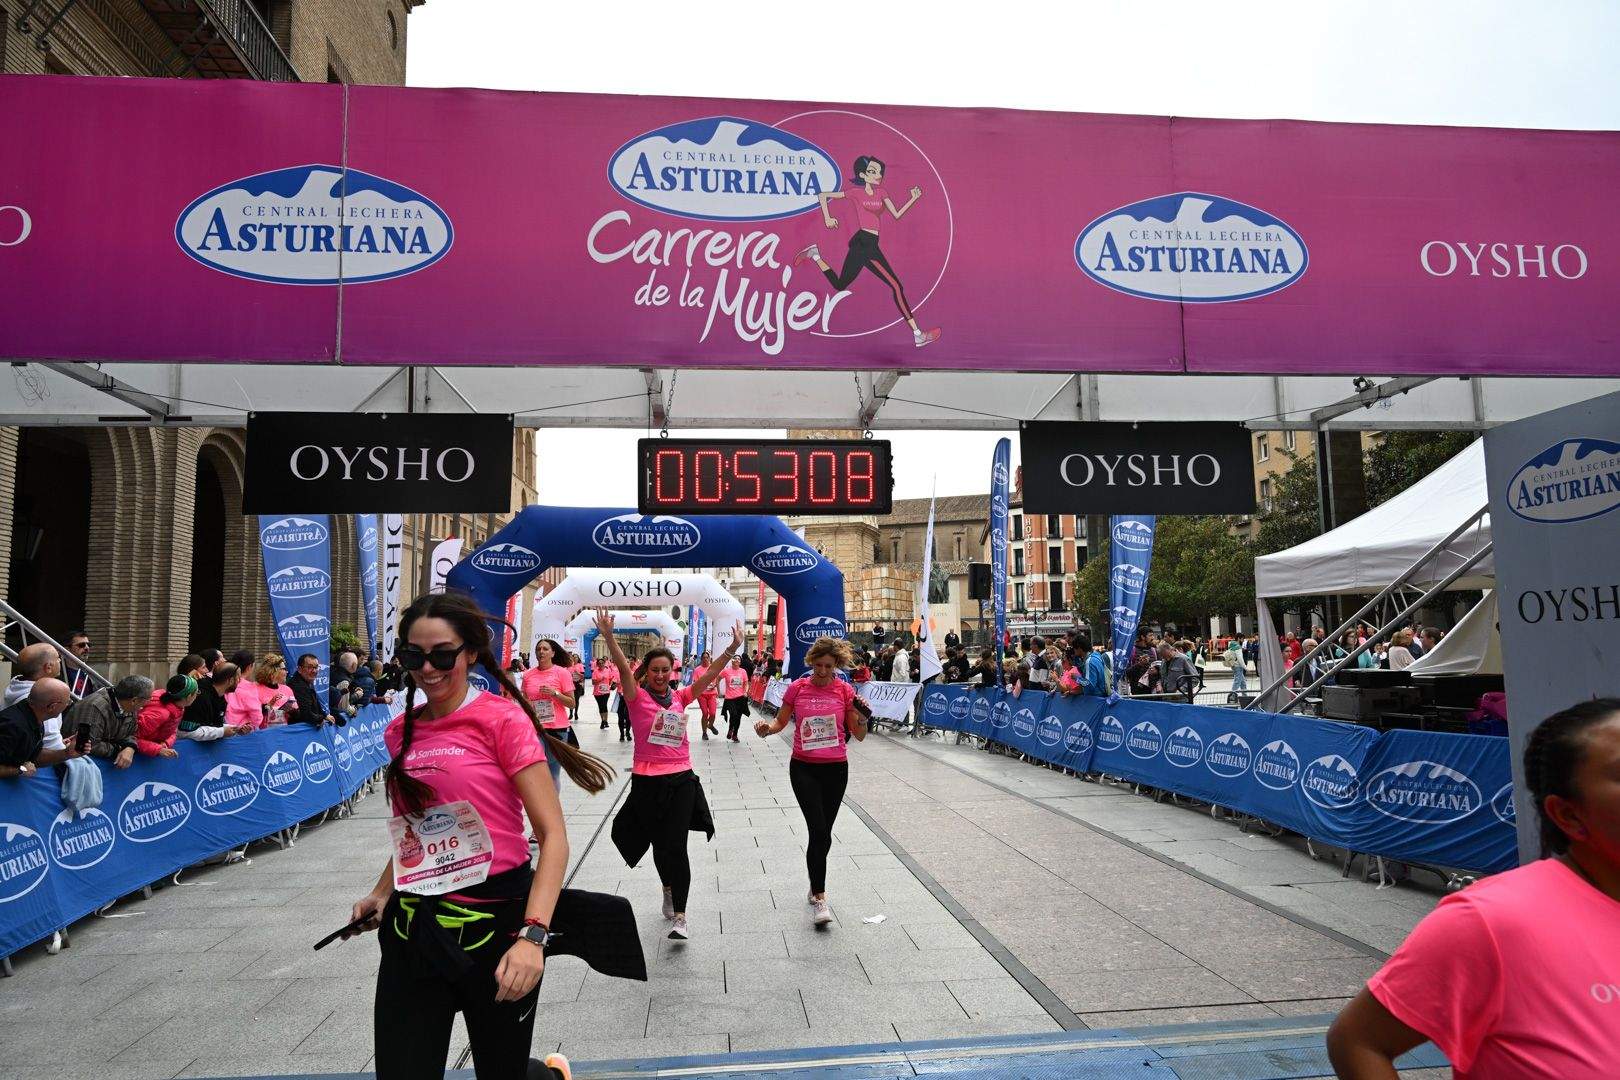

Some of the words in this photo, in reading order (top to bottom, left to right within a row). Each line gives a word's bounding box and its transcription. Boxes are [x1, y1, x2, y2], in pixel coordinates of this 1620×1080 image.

[663, 150, 737, 164] CENTRAL
[743, 153, 816, 166] LECHERA
[626, 151, 823, 197] ASTURIANA
[242, 205, 328, 218] CENTRAL
[337, 205, 424, 220] LECHERA
[197, 207, 433, 255] ASTURIANA
[586, 210, 780, 269] Carrera
[1129, 228, 1202, 242] CENTRAL
[1209, 230, 1284, 243] LECHERA
[1094, 231, 1292, 274] ASTURIANA
[1420, 240, 1589, 280] OYSHO
[634, 269, 670, 307] de
[679, 269, 705, 308] la
[699, 264, 852, 355] Mujer
[289, 444, 475, 483] OYSHO
[1059, 453, 1221, 487] OYSHO
[1533, 467, 1576, 483] CENTRAL
[1580, 457, 1620, 473] LECHE
[1516, 470, 1620, 510] ASTURIAN
[600, 525, 693, 546] ASTURIANA
[475, 553, 535, 568] ASTURIANA
[757, 557, 814, 568] ASTURIANA
[598, 580, 683, 598] OYSHO
[1517, 584, 1620, 624] OYSH
[534, 632, 561, 640] OYSHO
[869, 685, 908, 703] OYSHO
[417, 745, 467, 760] Santander
[1166, 739, 1200, 760] ASTURIANA
[1207, 746, 1248, 769] ASTURIANA
[268, 768, 301, 788] ASTURIANA
[201, 781, 257, 809] ASTURIANA
[1371, 780, 1472, 812] ASTURIANA
[125, 801, 187, 834] ASTURIANA
[56, 826, 112, 859] ASTURIANA
[427, 836, 459, 855] 016
[0, 848, 47, 882] URIANA
[435, 852, 456, 866] 9042
[444, 865, 453, 873] LA
